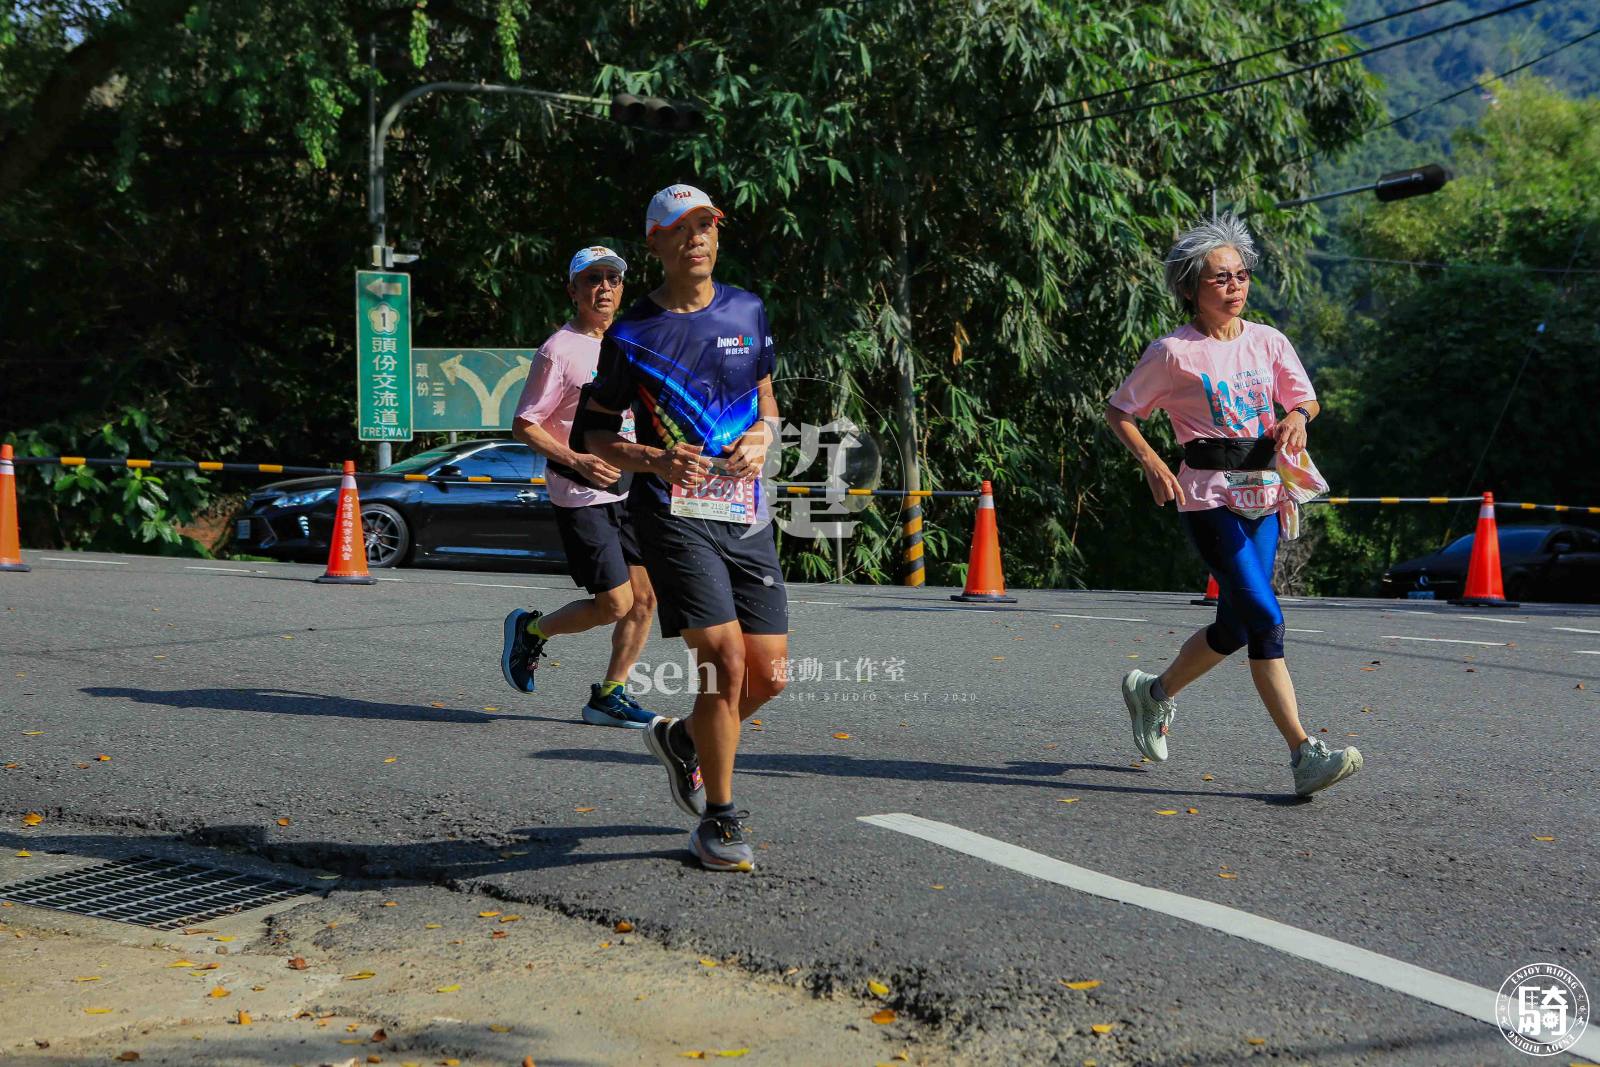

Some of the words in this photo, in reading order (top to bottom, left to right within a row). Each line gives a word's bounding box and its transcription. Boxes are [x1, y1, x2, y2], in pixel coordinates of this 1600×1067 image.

[381, 312, 388, 328] 1
[717, 335, 753, 348] INNOLUX
[372, 337, 399, 426] 頭份交流道
[363, 427, 408, 438] FREEWAY
